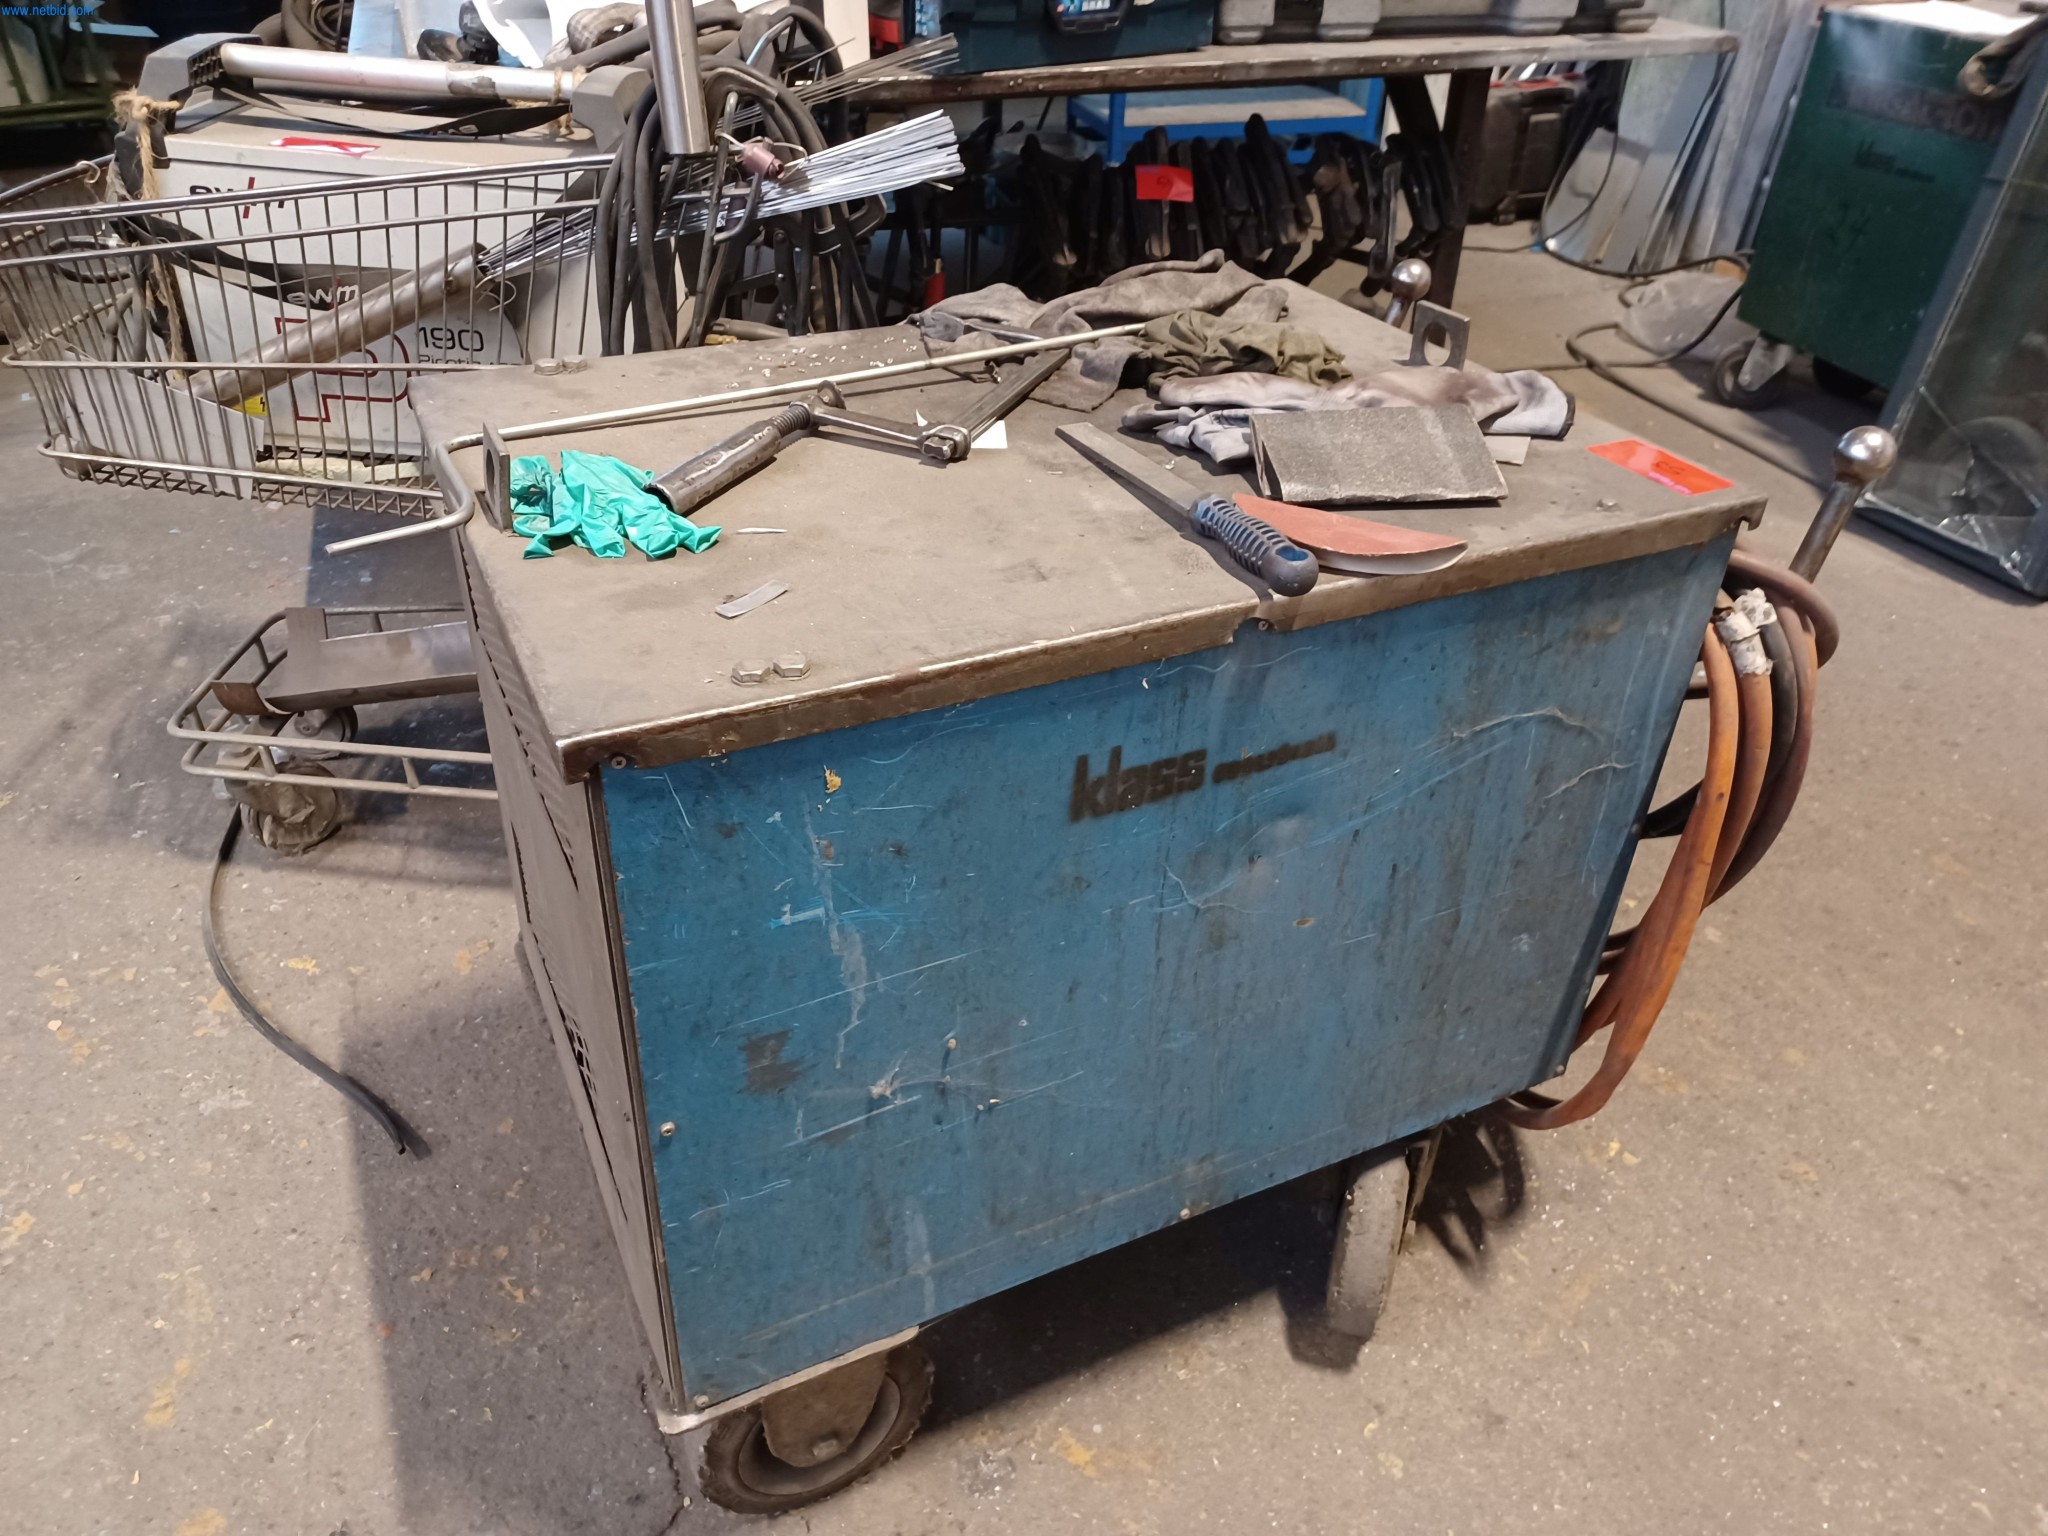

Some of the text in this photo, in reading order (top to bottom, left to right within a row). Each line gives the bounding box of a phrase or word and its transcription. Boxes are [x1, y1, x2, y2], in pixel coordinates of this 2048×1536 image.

[287, 284, 359, 305] ewm
[418, 326, 485, 353] 190
[418, 353, 482, 366] Picoti
